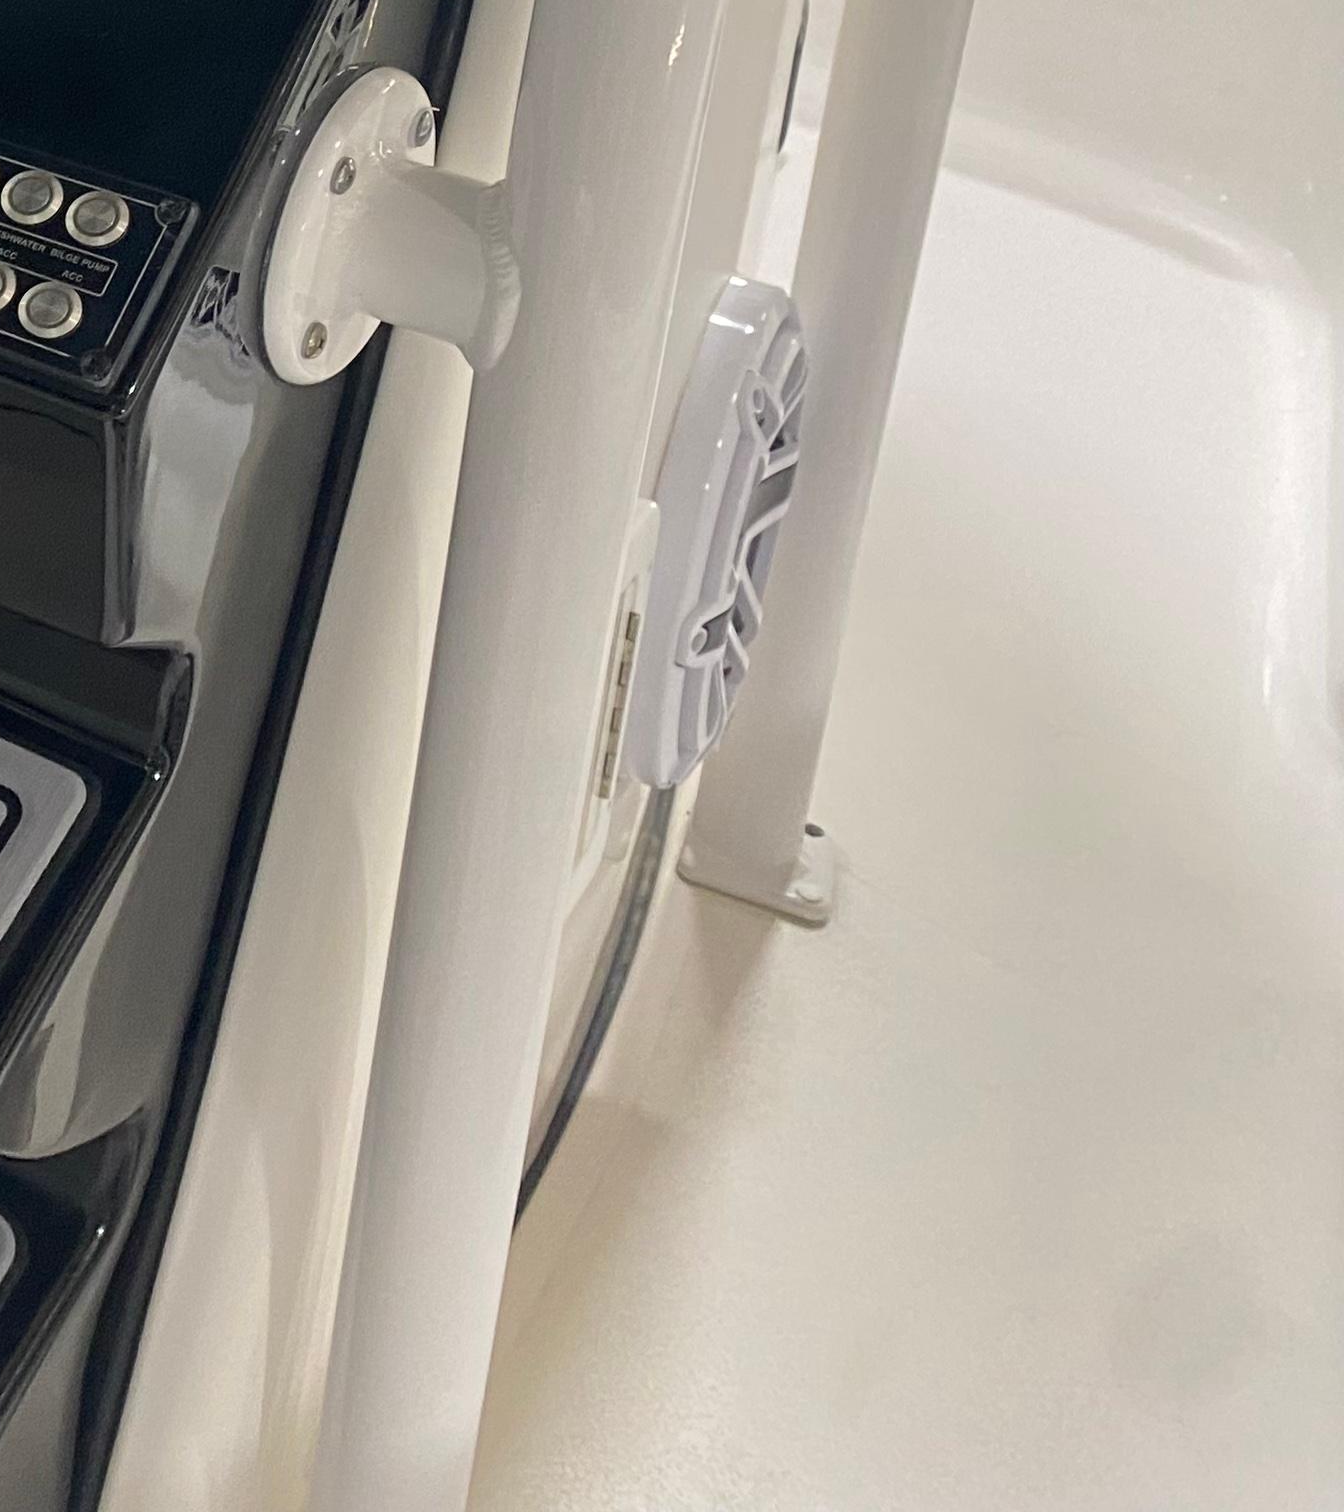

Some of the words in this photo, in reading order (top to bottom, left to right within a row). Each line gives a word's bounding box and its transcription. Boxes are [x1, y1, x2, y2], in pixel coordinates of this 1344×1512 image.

[49, 248, 81, 264] BILGE
[81, 258, 110, 274] PUMP
[61, 270, 84, 283] ACC
